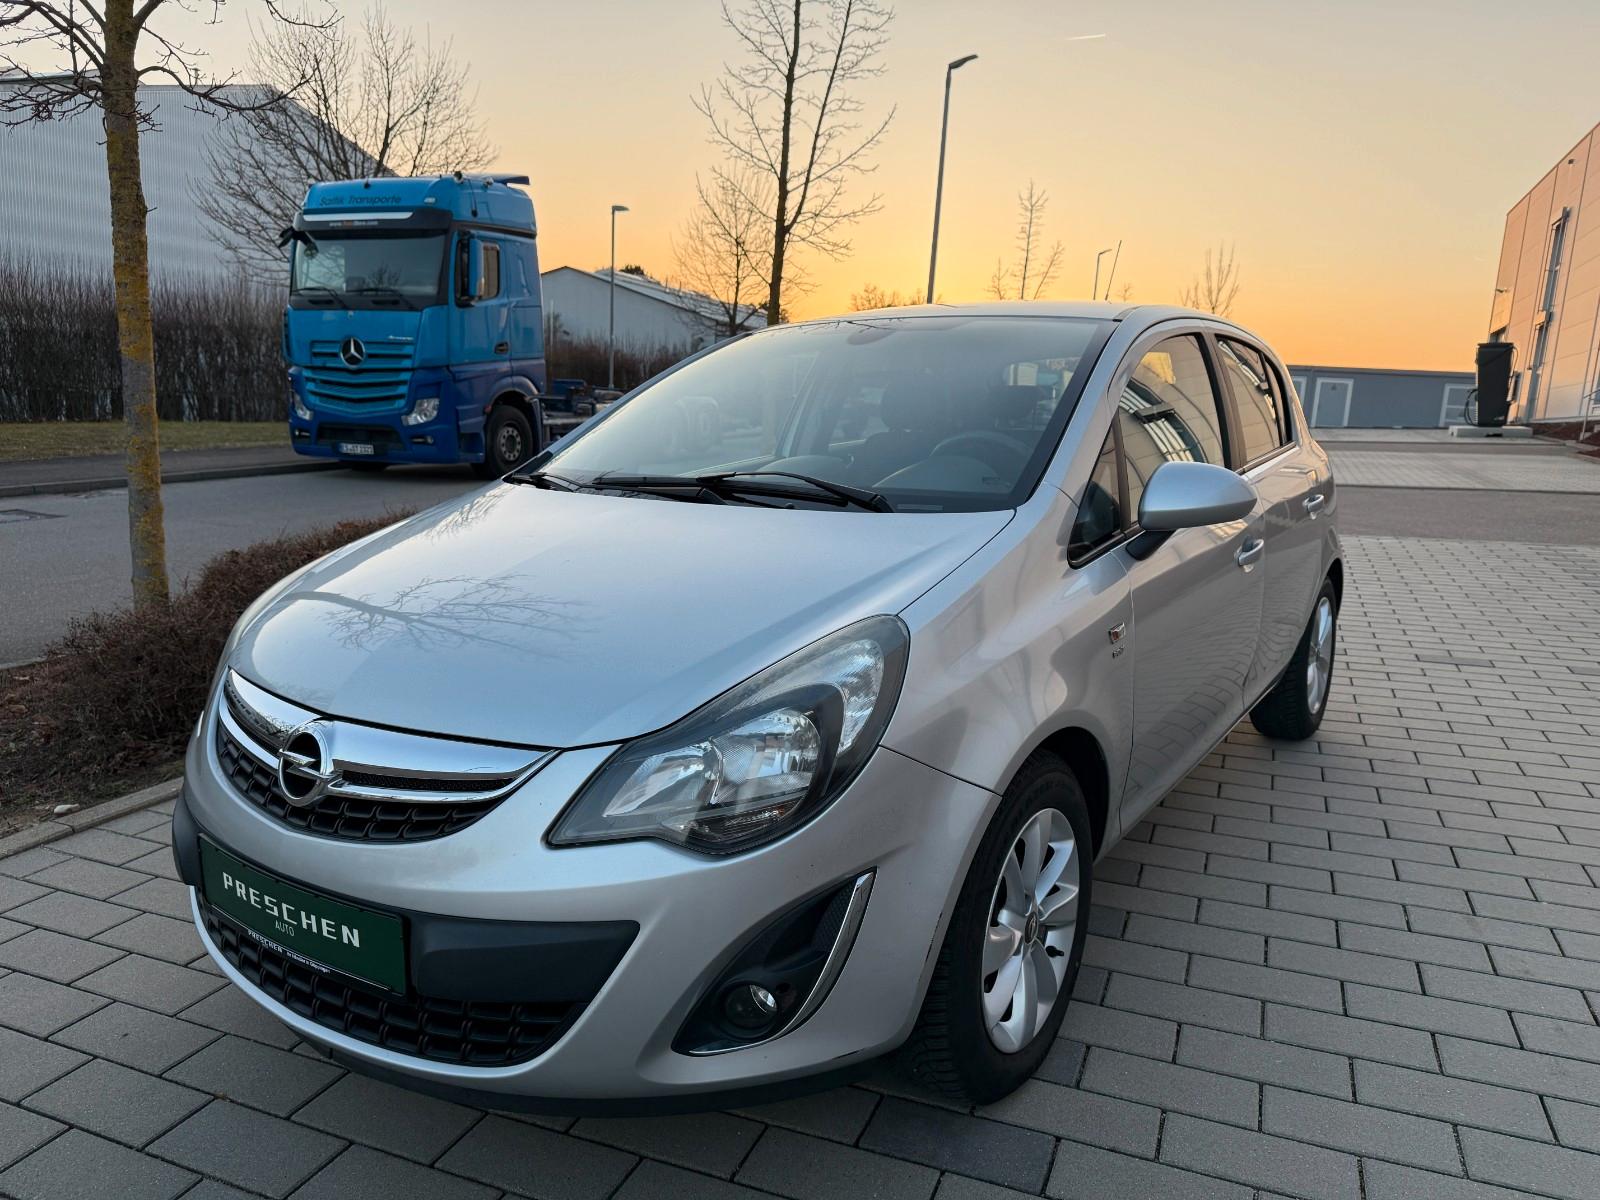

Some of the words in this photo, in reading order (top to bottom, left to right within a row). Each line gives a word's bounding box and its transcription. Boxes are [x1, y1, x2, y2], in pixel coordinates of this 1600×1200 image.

[222, 871, 360, 948] PRESCHEN
[247, 928, 283, 953] PRESCHEN
[275, 919, 295, 937] AUTO
